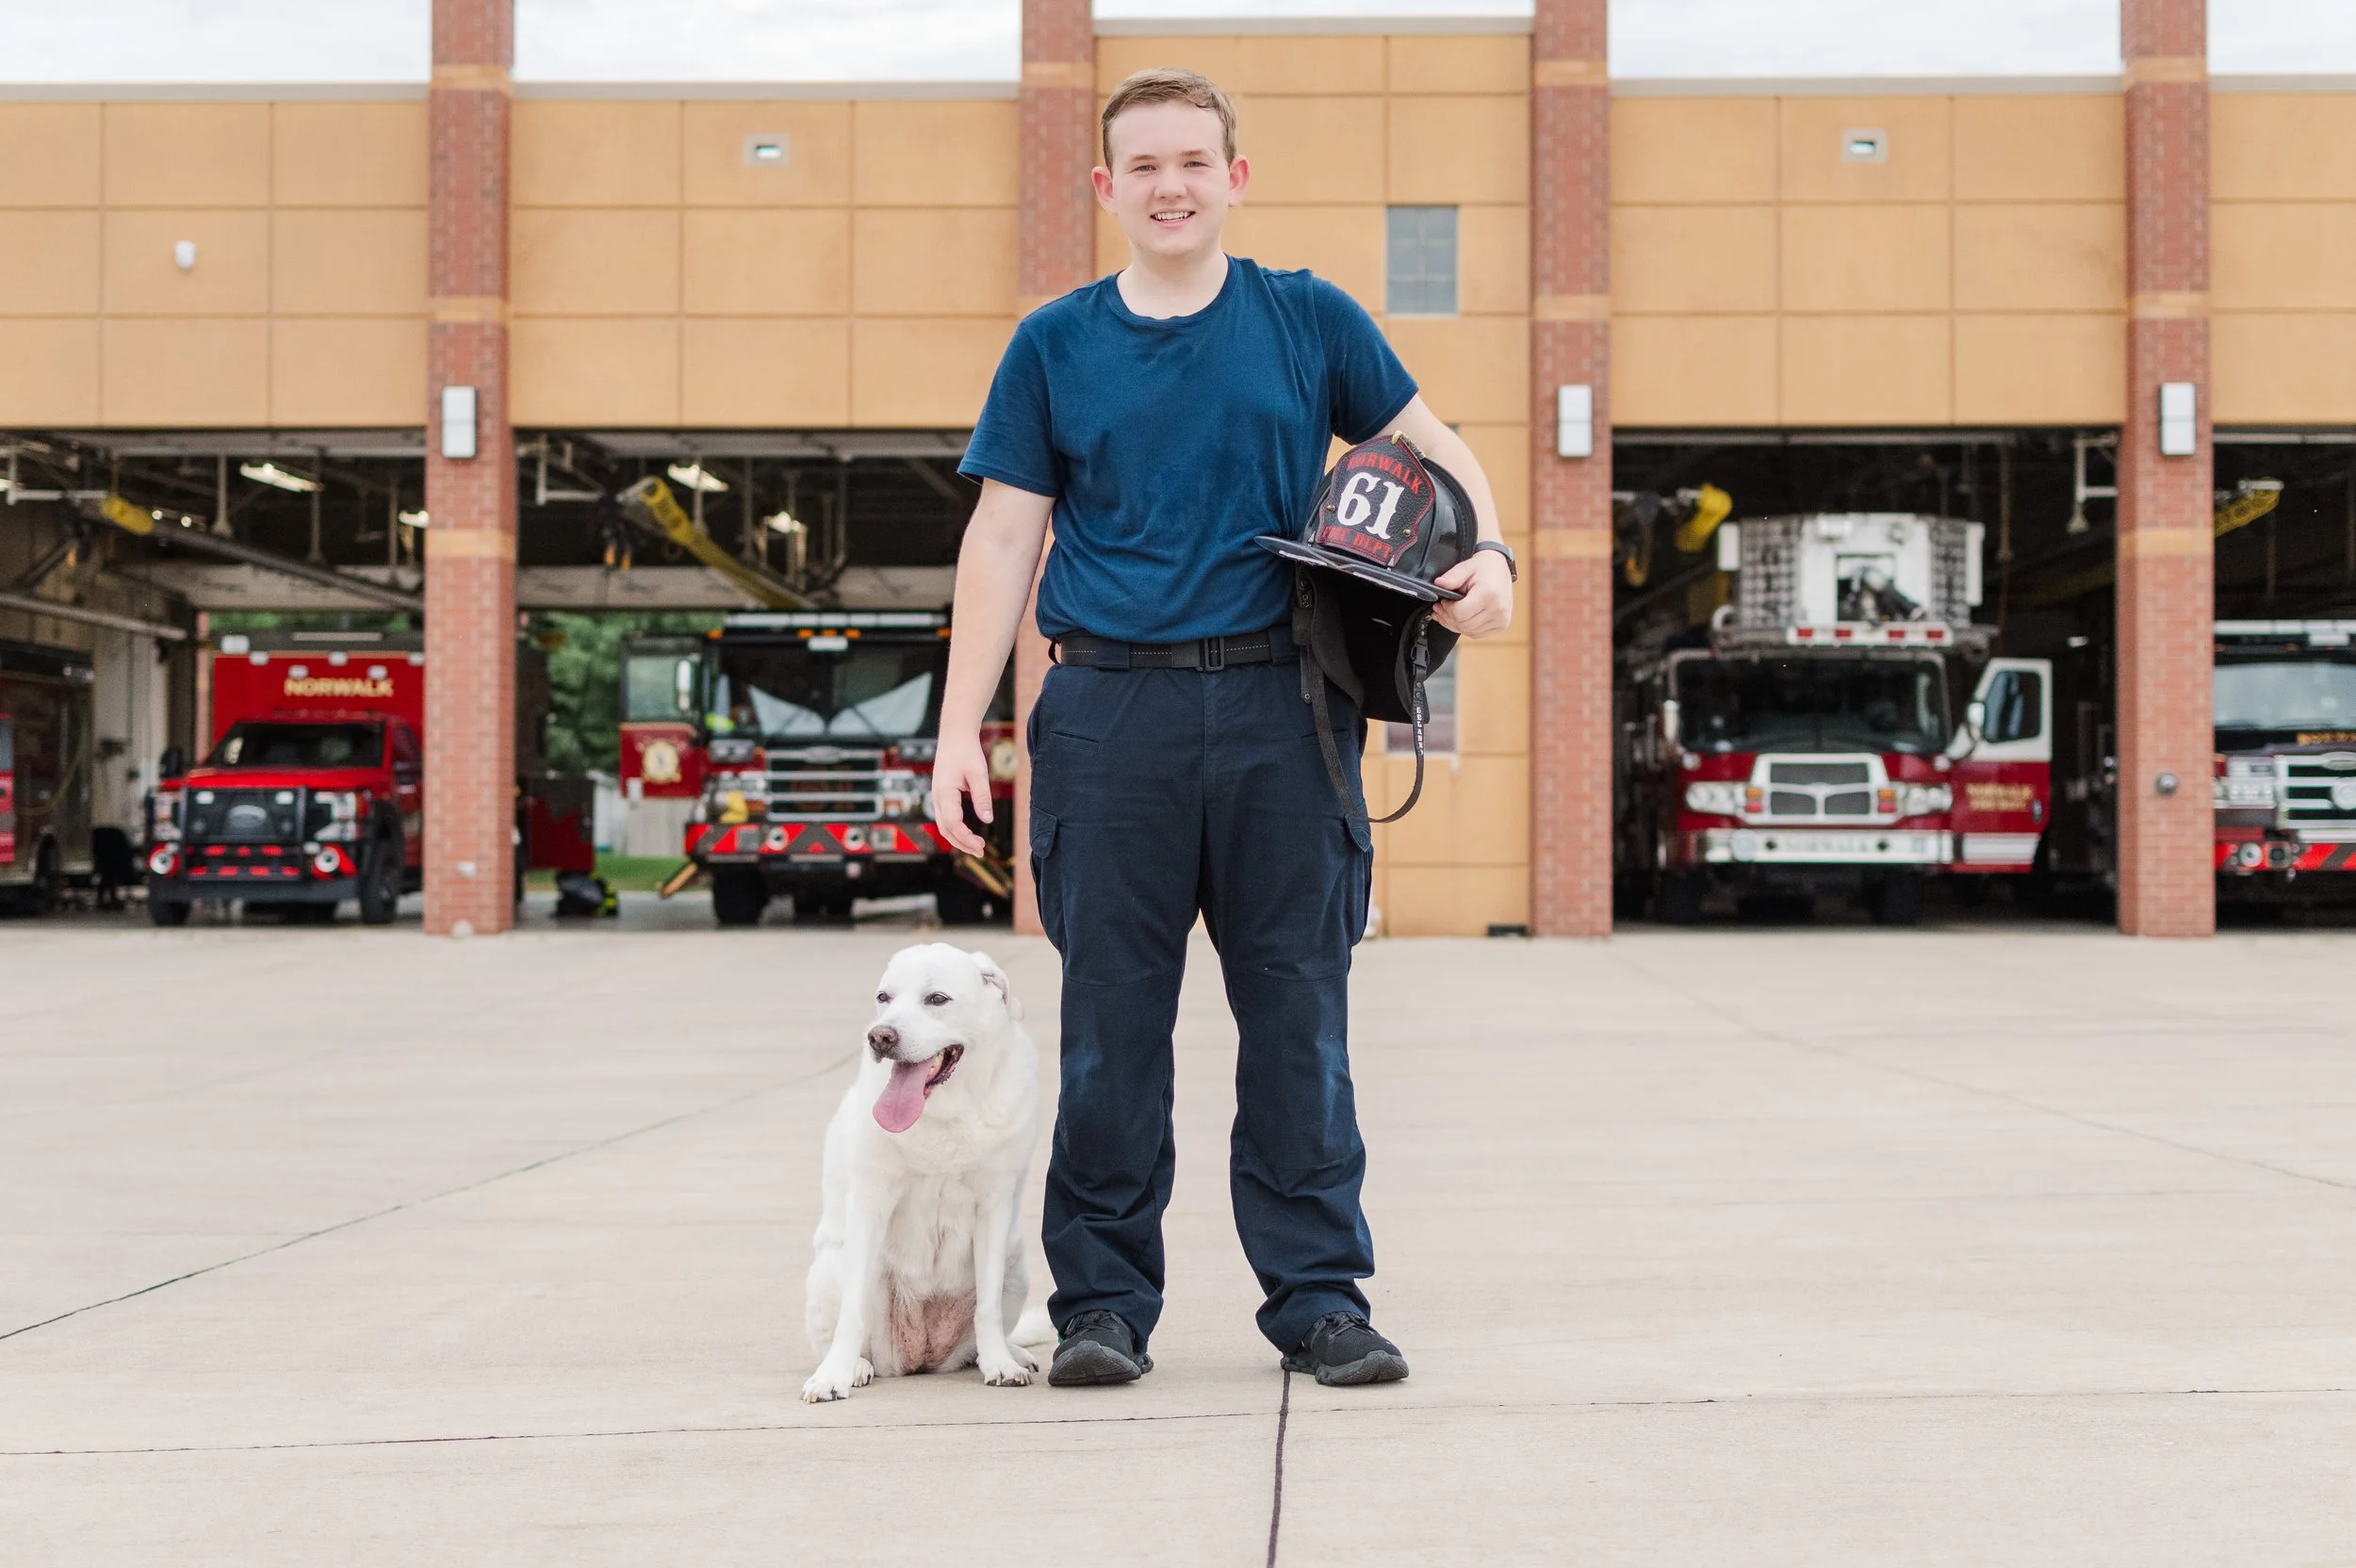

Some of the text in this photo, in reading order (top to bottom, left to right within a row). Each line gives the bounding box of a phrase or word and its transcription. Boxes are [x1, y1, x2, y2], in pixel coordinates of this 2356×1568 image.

[1346, 452, 1421, 496] NORWALK
[1337, 472, 1404, 539] 61
[1352, 531, 1393, 559] DEPT
[284, 678, 394, 697] NORWALK
